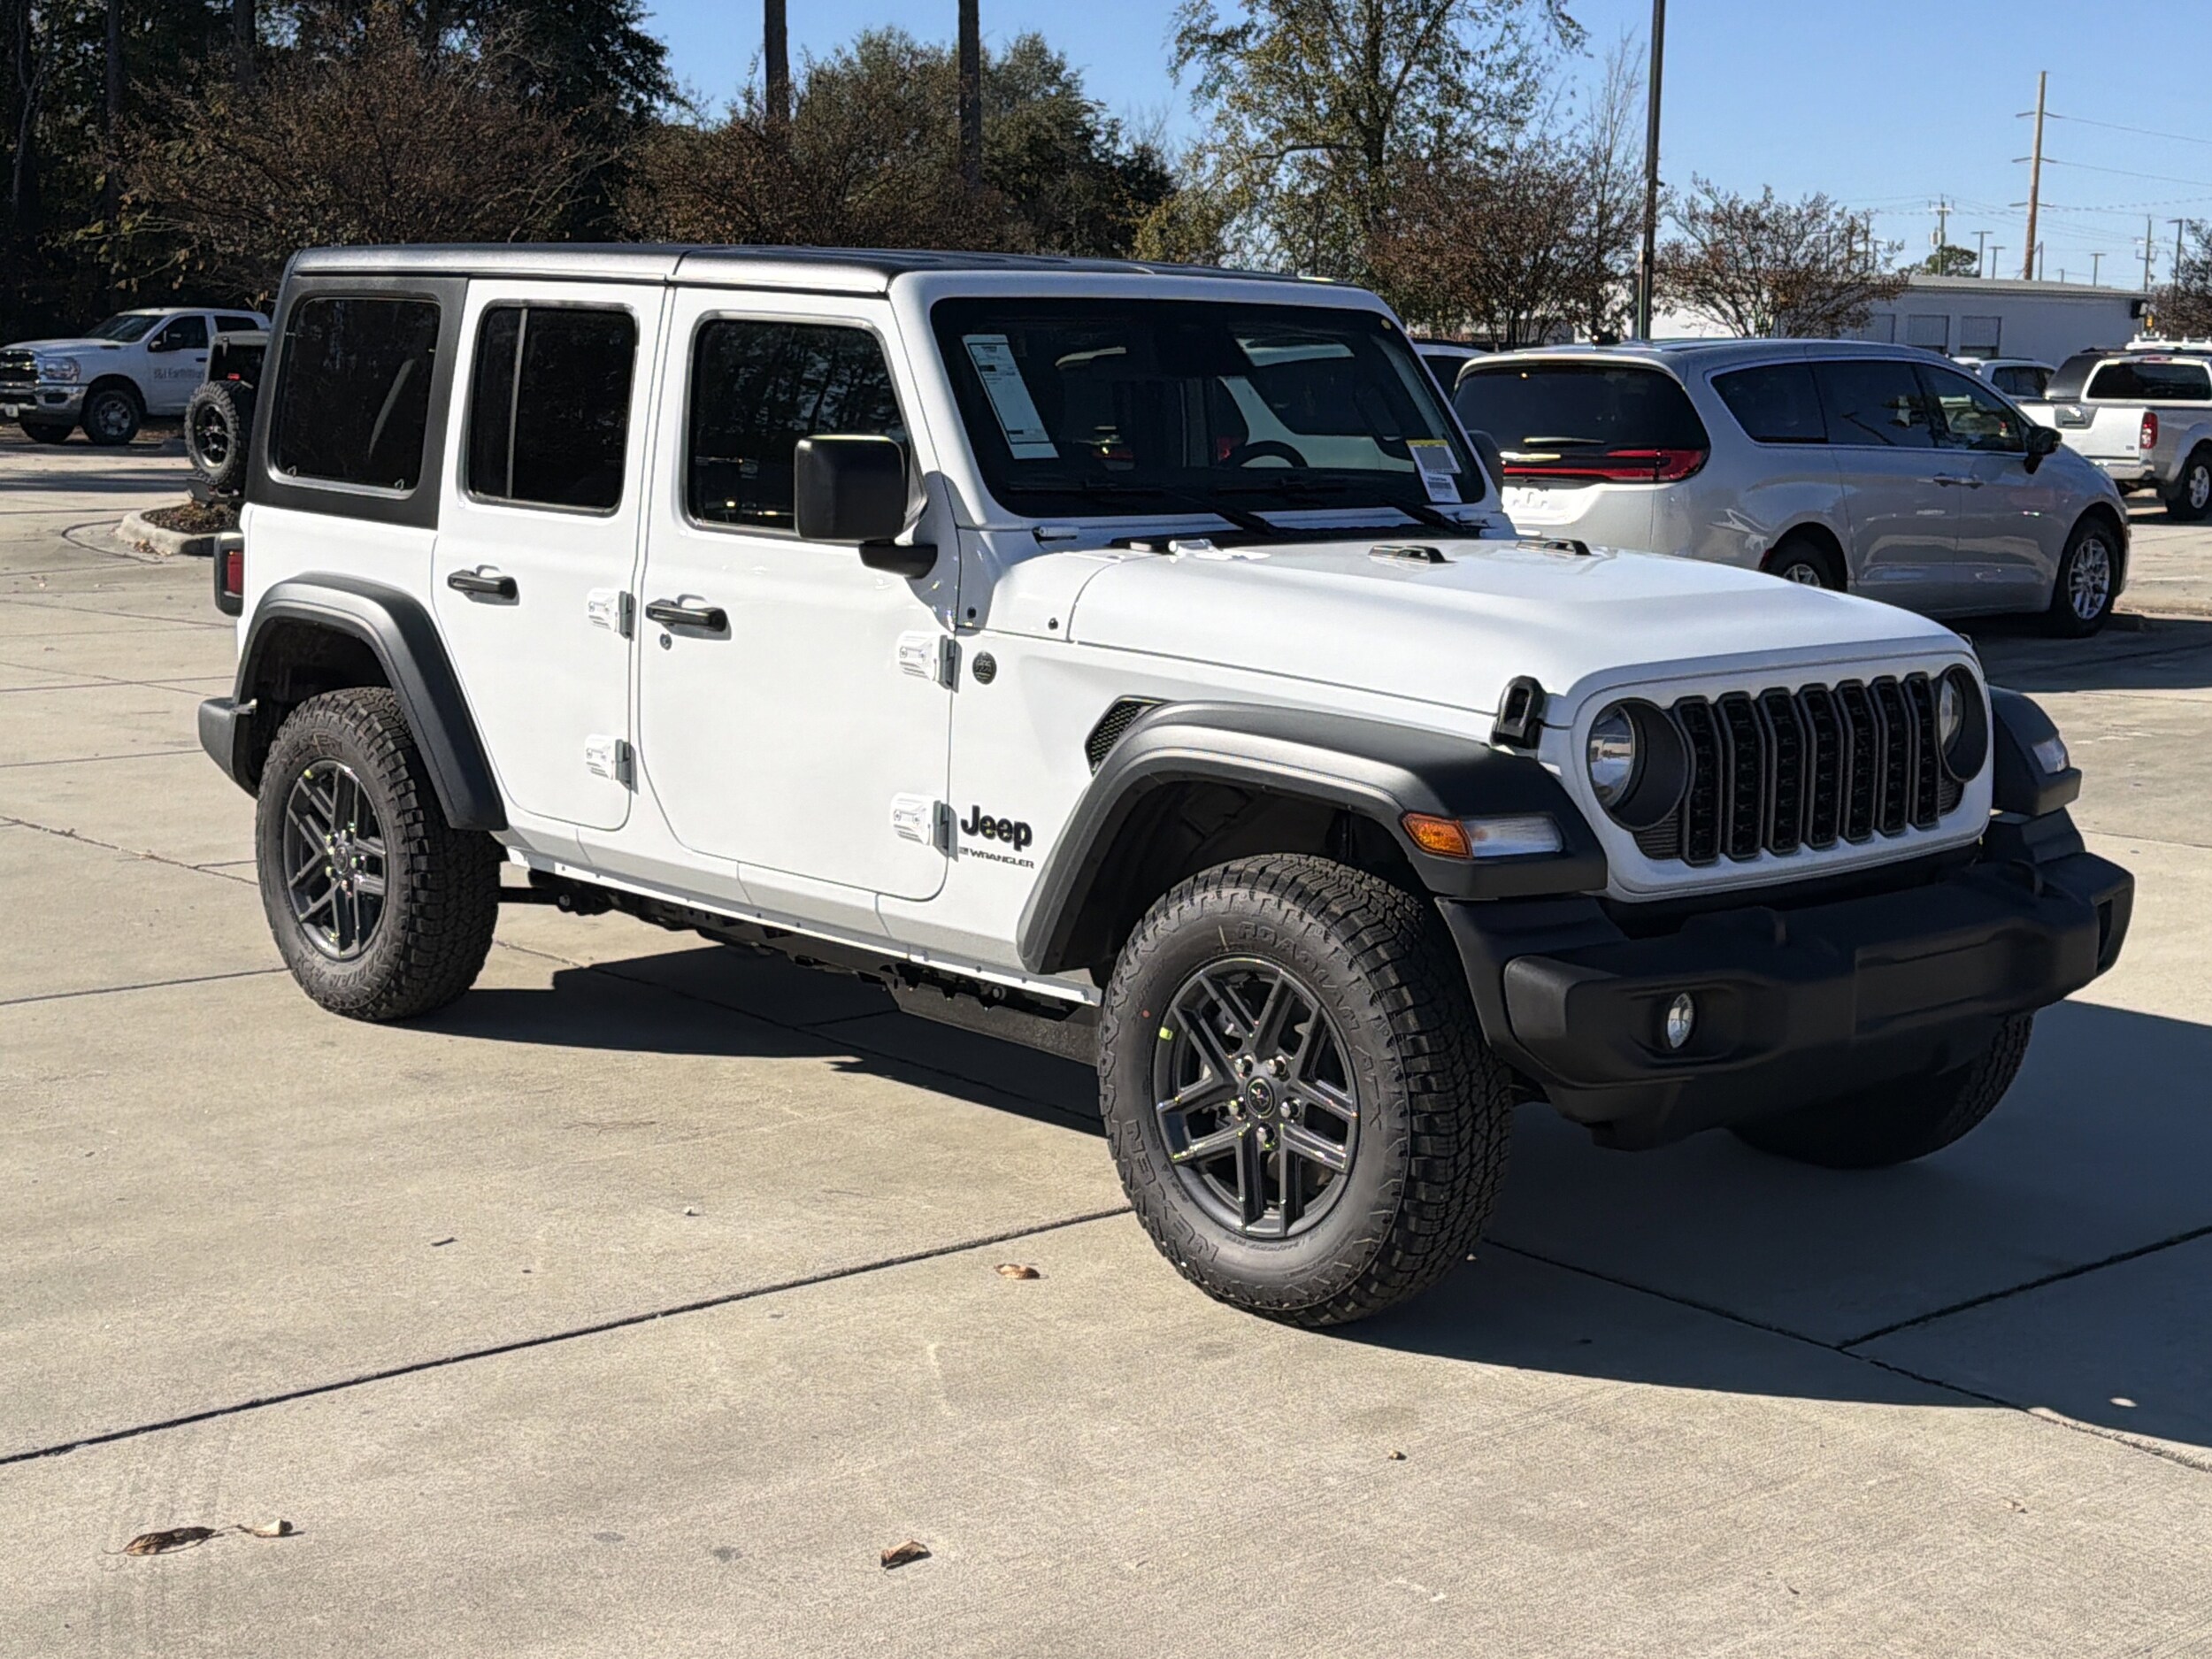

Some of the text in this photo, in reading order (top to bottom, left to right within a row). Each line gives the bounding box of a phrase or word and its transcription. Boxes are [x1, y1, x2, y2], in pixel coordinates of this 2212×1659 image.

[960, 804, 1033, 852] Jeep
[970, 849, 1034, 869] WRANGLER
[1238, 921, 1360, 1030] ROADIAN
[1124, 1118, 1220, 1263] NEXEN
